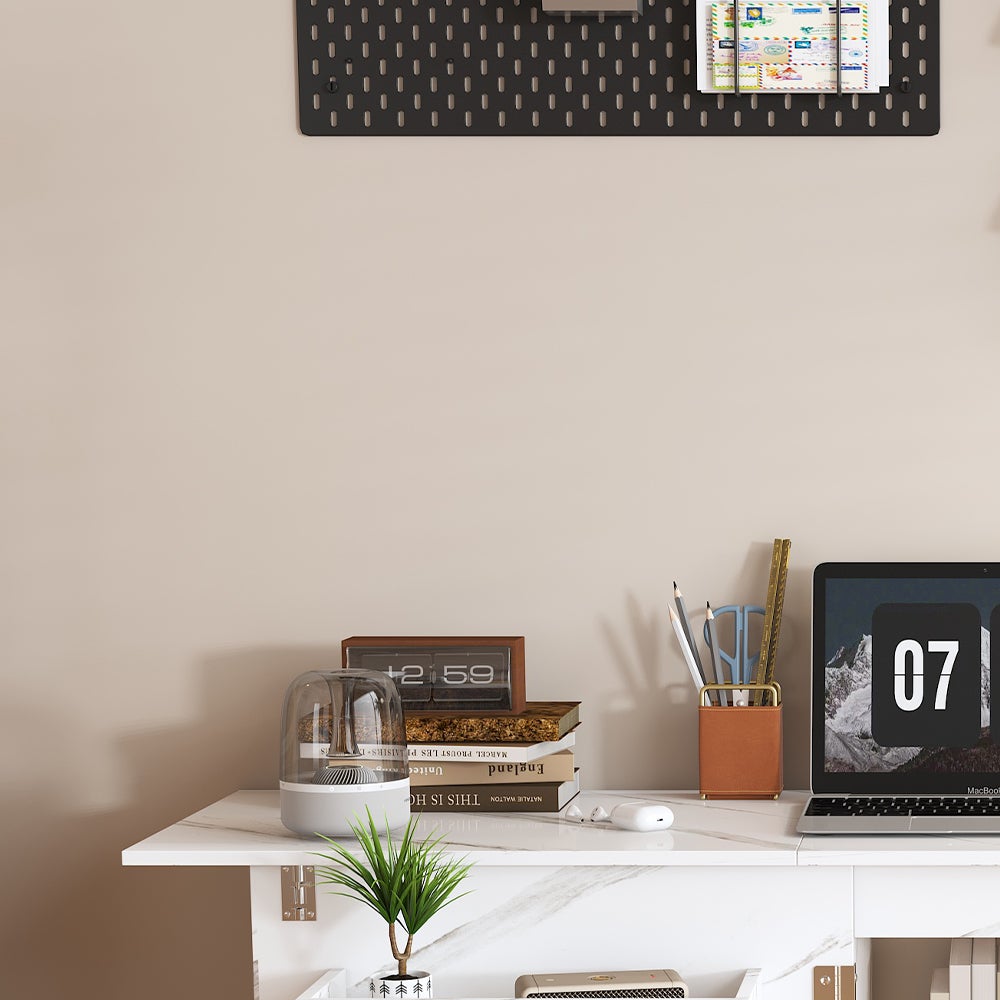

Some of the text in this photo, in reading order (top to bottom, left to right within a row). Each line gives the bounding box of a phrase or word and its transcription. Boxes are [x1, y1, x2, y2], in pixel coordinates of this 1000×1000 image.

[893, 638, 960, 712] 07
[421, 749, 438, 757] LES
[476, 750, 508, 758] MARCEL
[488, 762, 544, 776] England
[431, 794, 443, 805] IS
[447, 794, 481, 806] THIS
